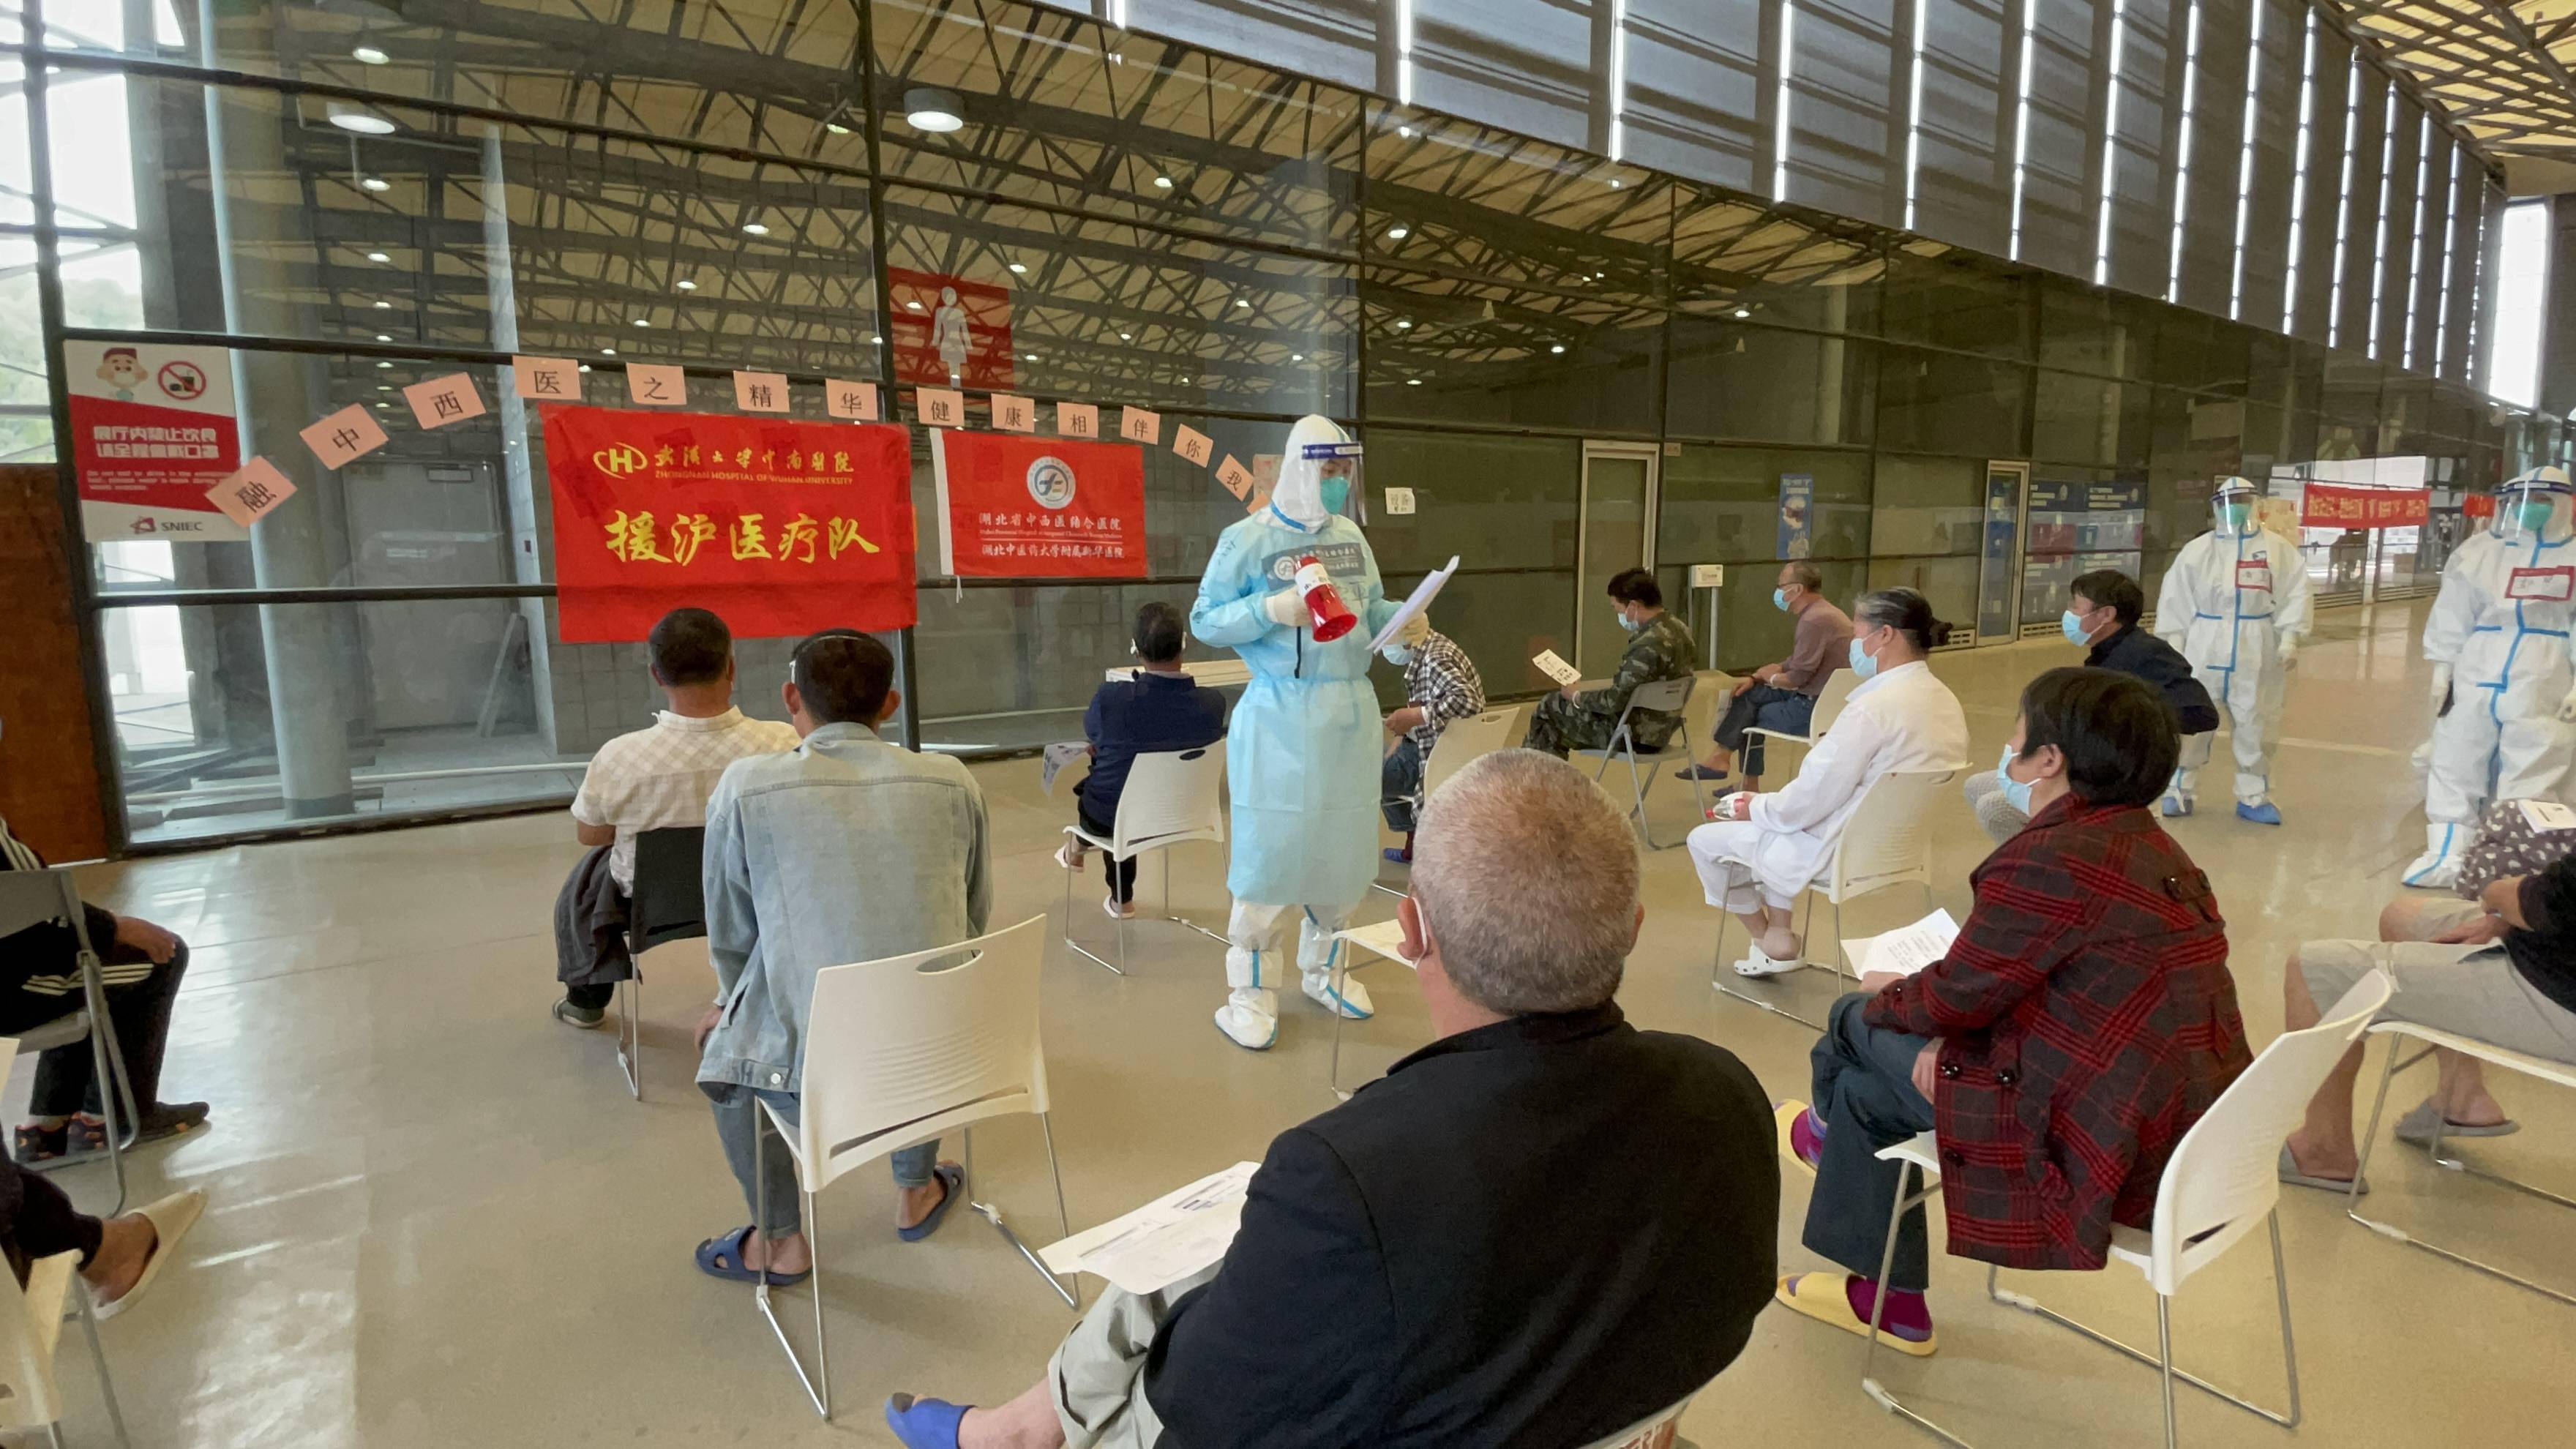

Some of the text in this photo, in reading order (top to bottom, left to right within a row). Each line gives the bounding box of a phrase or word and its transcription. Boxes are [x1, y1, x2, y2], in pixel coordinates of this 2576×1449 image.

[235, 370, 1243, 512] 融 中 西 医 之 精 华 健 康 相 伴 你 我
[160, 521, 203, 531] SNIEC
[604, 509, 880, 567] 援沪医疗队
